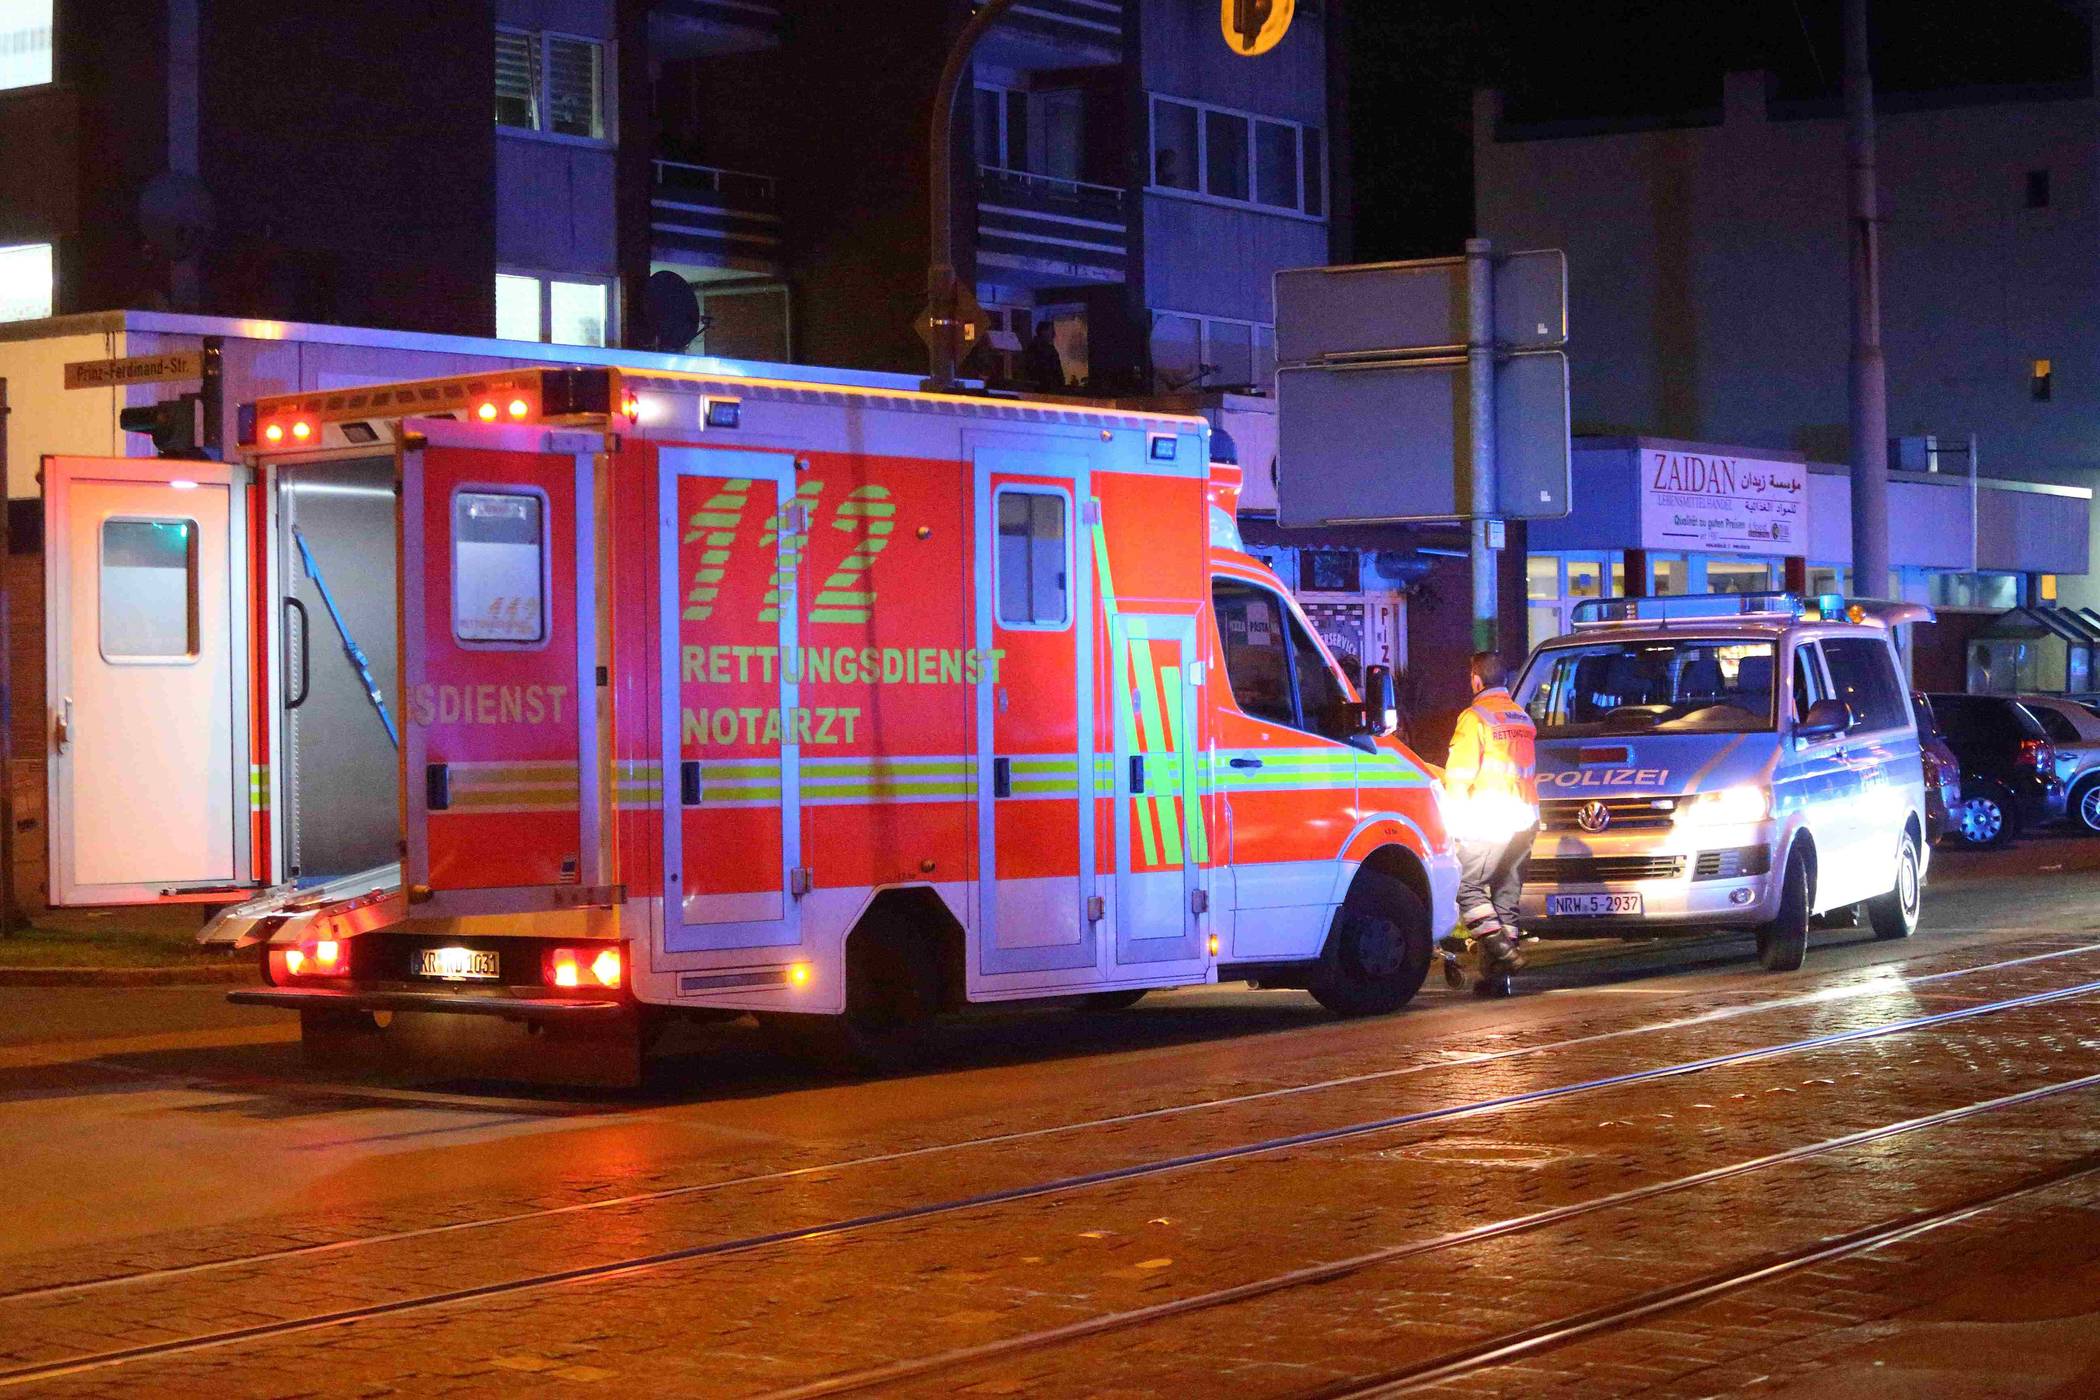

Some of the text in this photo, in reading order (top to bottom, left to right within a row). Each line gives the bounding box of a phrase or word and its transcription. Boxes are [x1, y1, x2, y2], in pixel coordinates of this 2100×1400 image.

[1653, 453, 1737, 495] ZAIDAN
[682, 478, 896, 624] 112
[682, 645, 1006, 685] RETTUNGSDIENST
[682, 706, 861, 745] NOTARZT
[1533, 769, 1669, 787] POLIZEI
[1556, 896, 1638, 913] NRW 5-2937
[422, 951, 436, 973] KR
[467, 953, 496, 974] 1031
